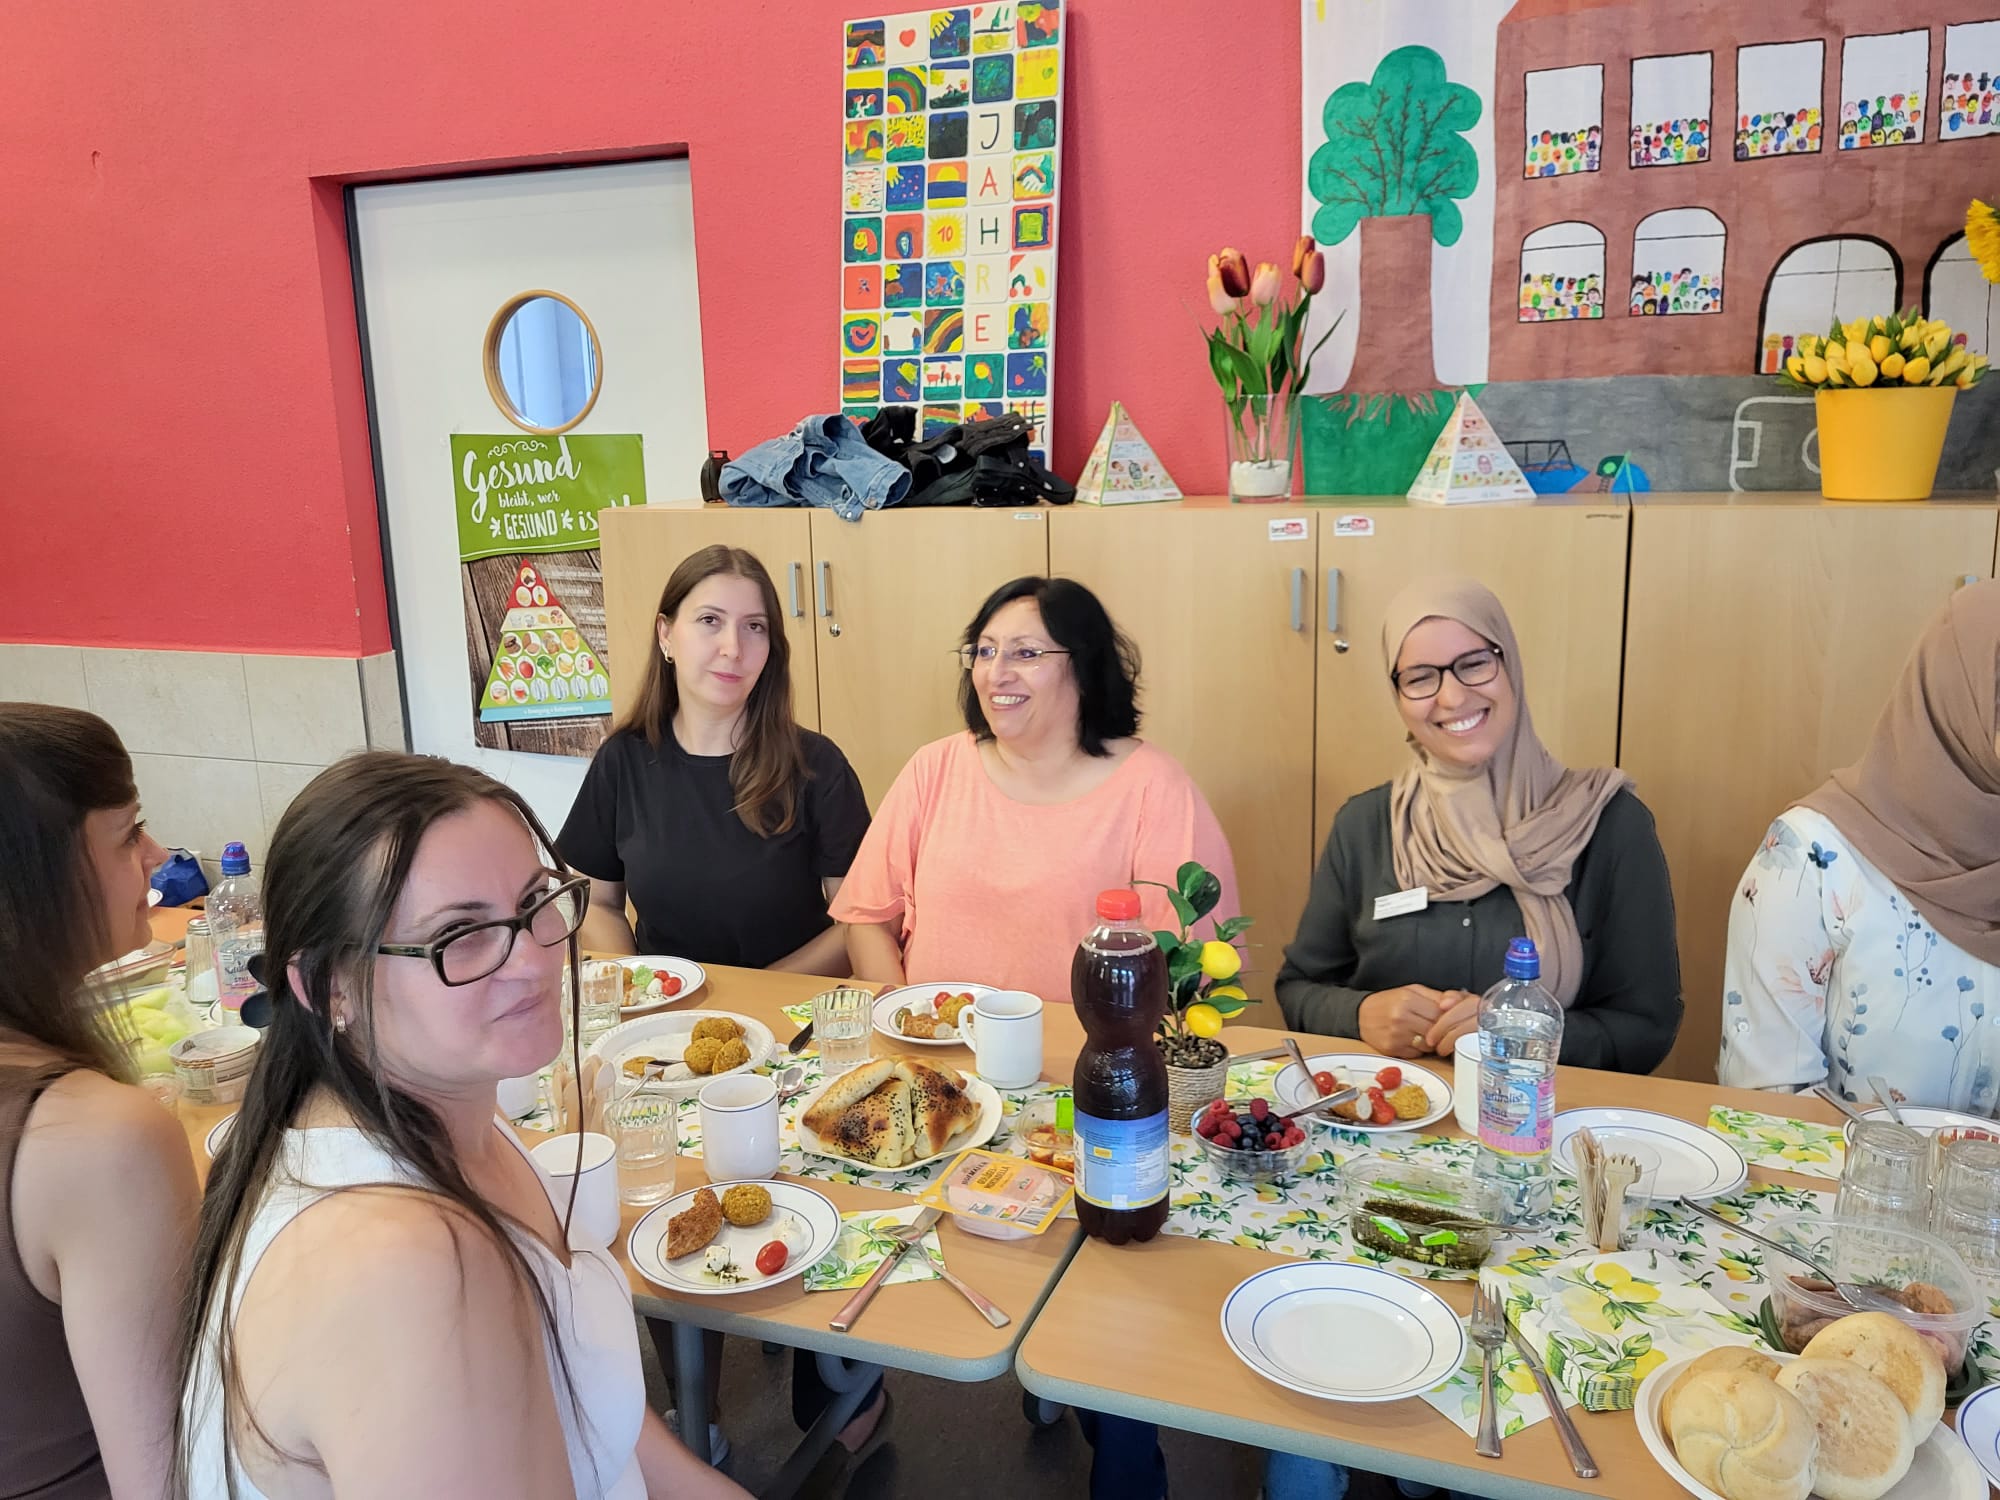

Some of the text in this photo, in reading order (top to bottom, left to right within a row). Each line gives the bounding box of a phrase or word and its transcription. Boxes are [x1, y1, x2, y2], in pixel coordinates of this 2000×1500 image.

[937, 225, 954, 243] 10
[463, 436, 581, 524] Gesund
[498, 489, 560, 508] bleibt, wer
[503, 509, 558, 540] GESUND
